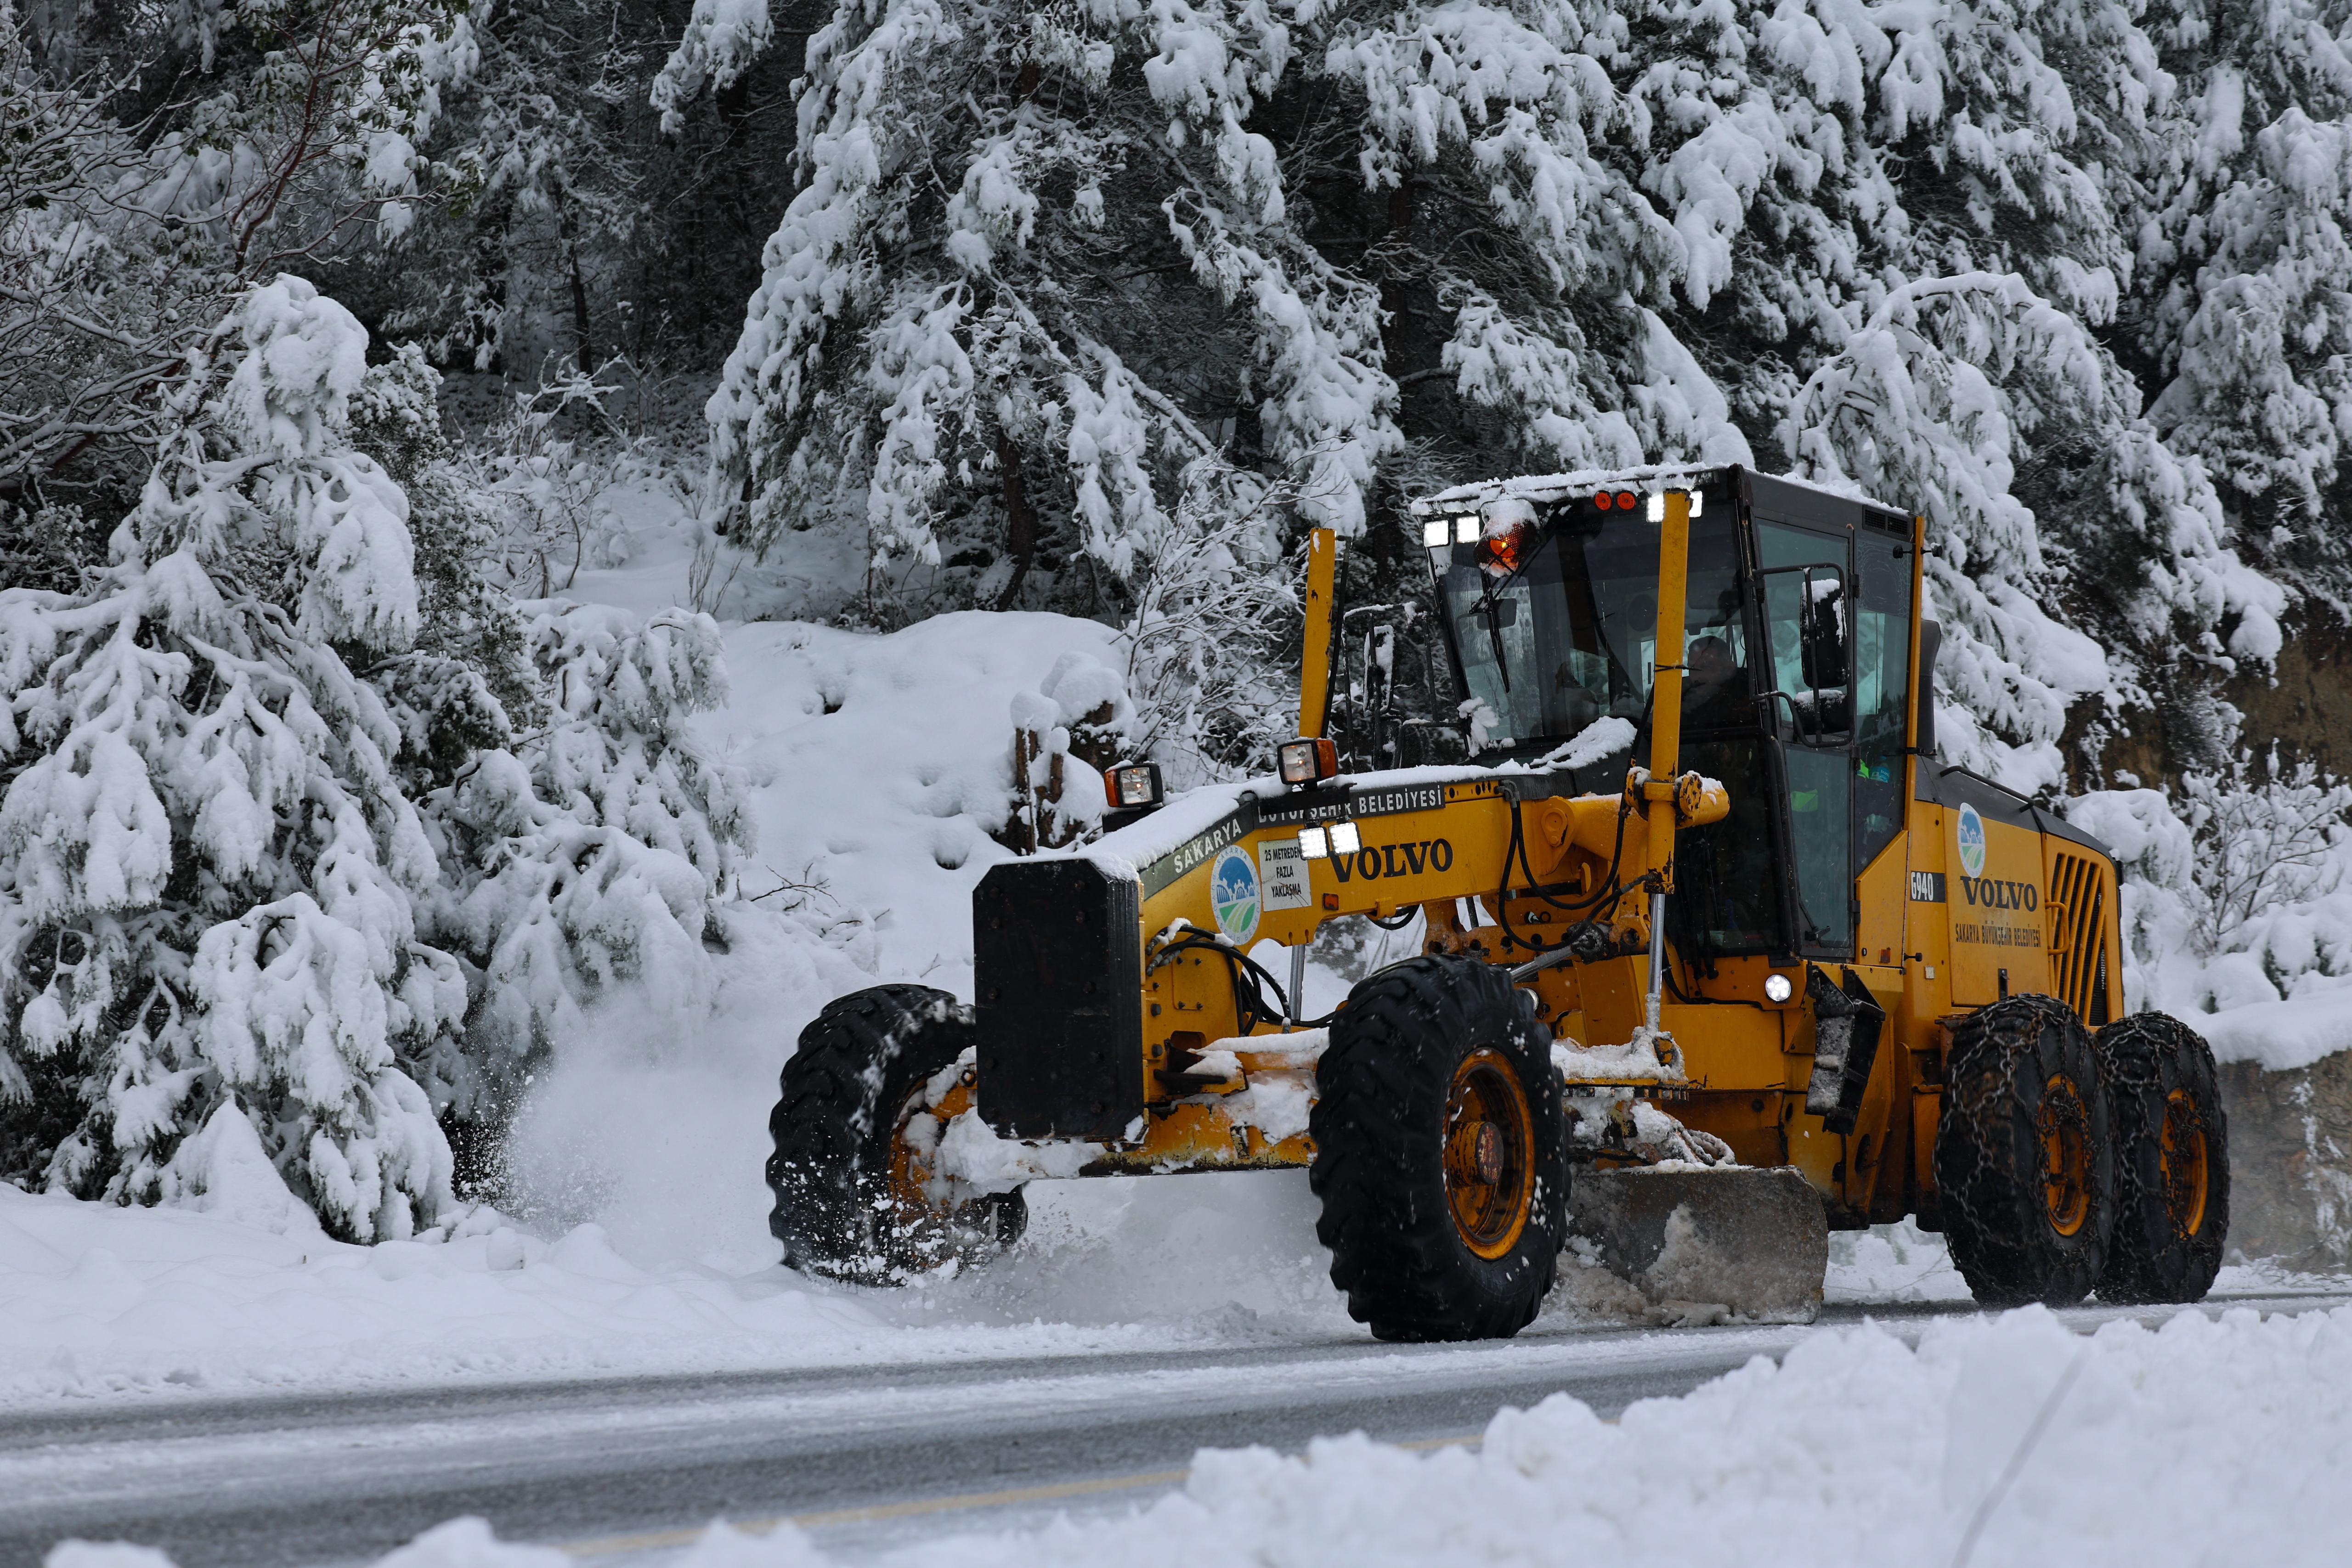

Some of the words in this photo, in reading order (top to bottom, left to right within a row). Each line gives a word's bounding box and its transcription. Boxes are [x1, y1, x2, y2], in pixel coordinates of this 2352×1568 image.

[1174, 818, 1242, 873] SAKARYA
[1359, 785, 1442, 814] BELEDİYESİ
[1265, 849, 1272, 861] 25
[1273, 846, 1301, 860] METREDEN
[1329, 838, 1453, 883] VOLVO
[1276, 866, 1294, 878] FAZLA
[1271, 883, 1301, 899] YAKLAŞMA
[1911, 872, 1934, 901] G940
[1960, 875, 2037, 912] VOLVO
[1956, 923, 1979, 943] SAKARYA
[2013, 924, 2041, 948] BELEDİYESİ
